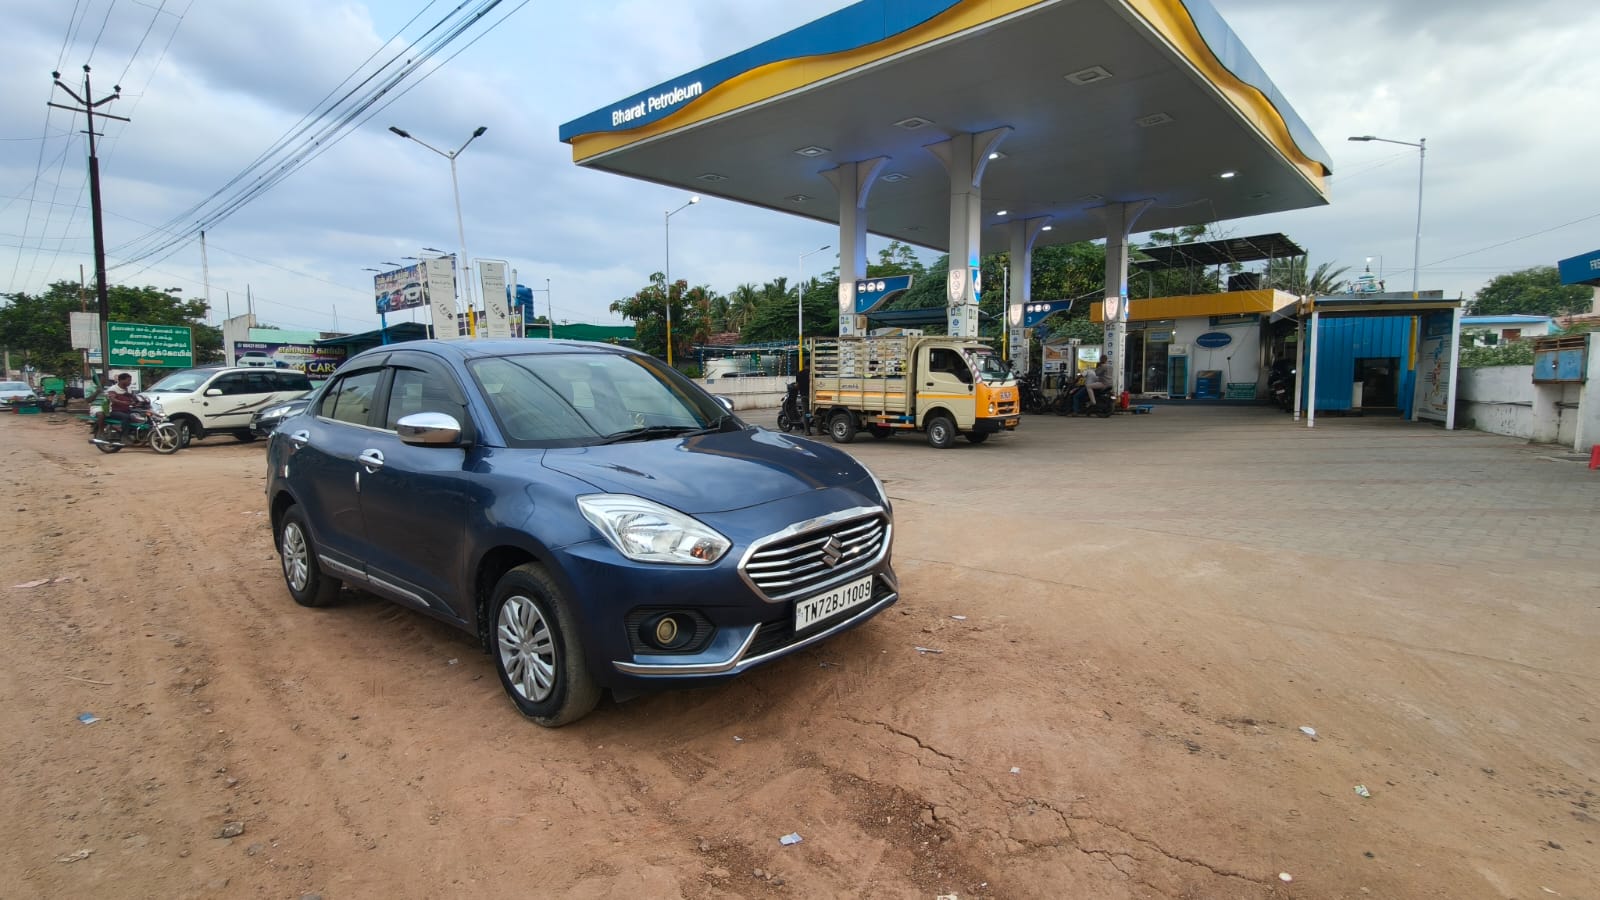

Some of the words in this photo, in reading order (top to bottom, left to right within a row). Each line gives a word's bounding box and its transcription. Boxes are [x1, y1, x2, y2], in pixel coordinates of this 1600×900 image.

[612, 101, 646, 126] Bharat
[648, 81, 702, 112] Petroleum
[309, 363, 336, 373] CARS
[803, 581, 871, 622] TN72BJ1009
